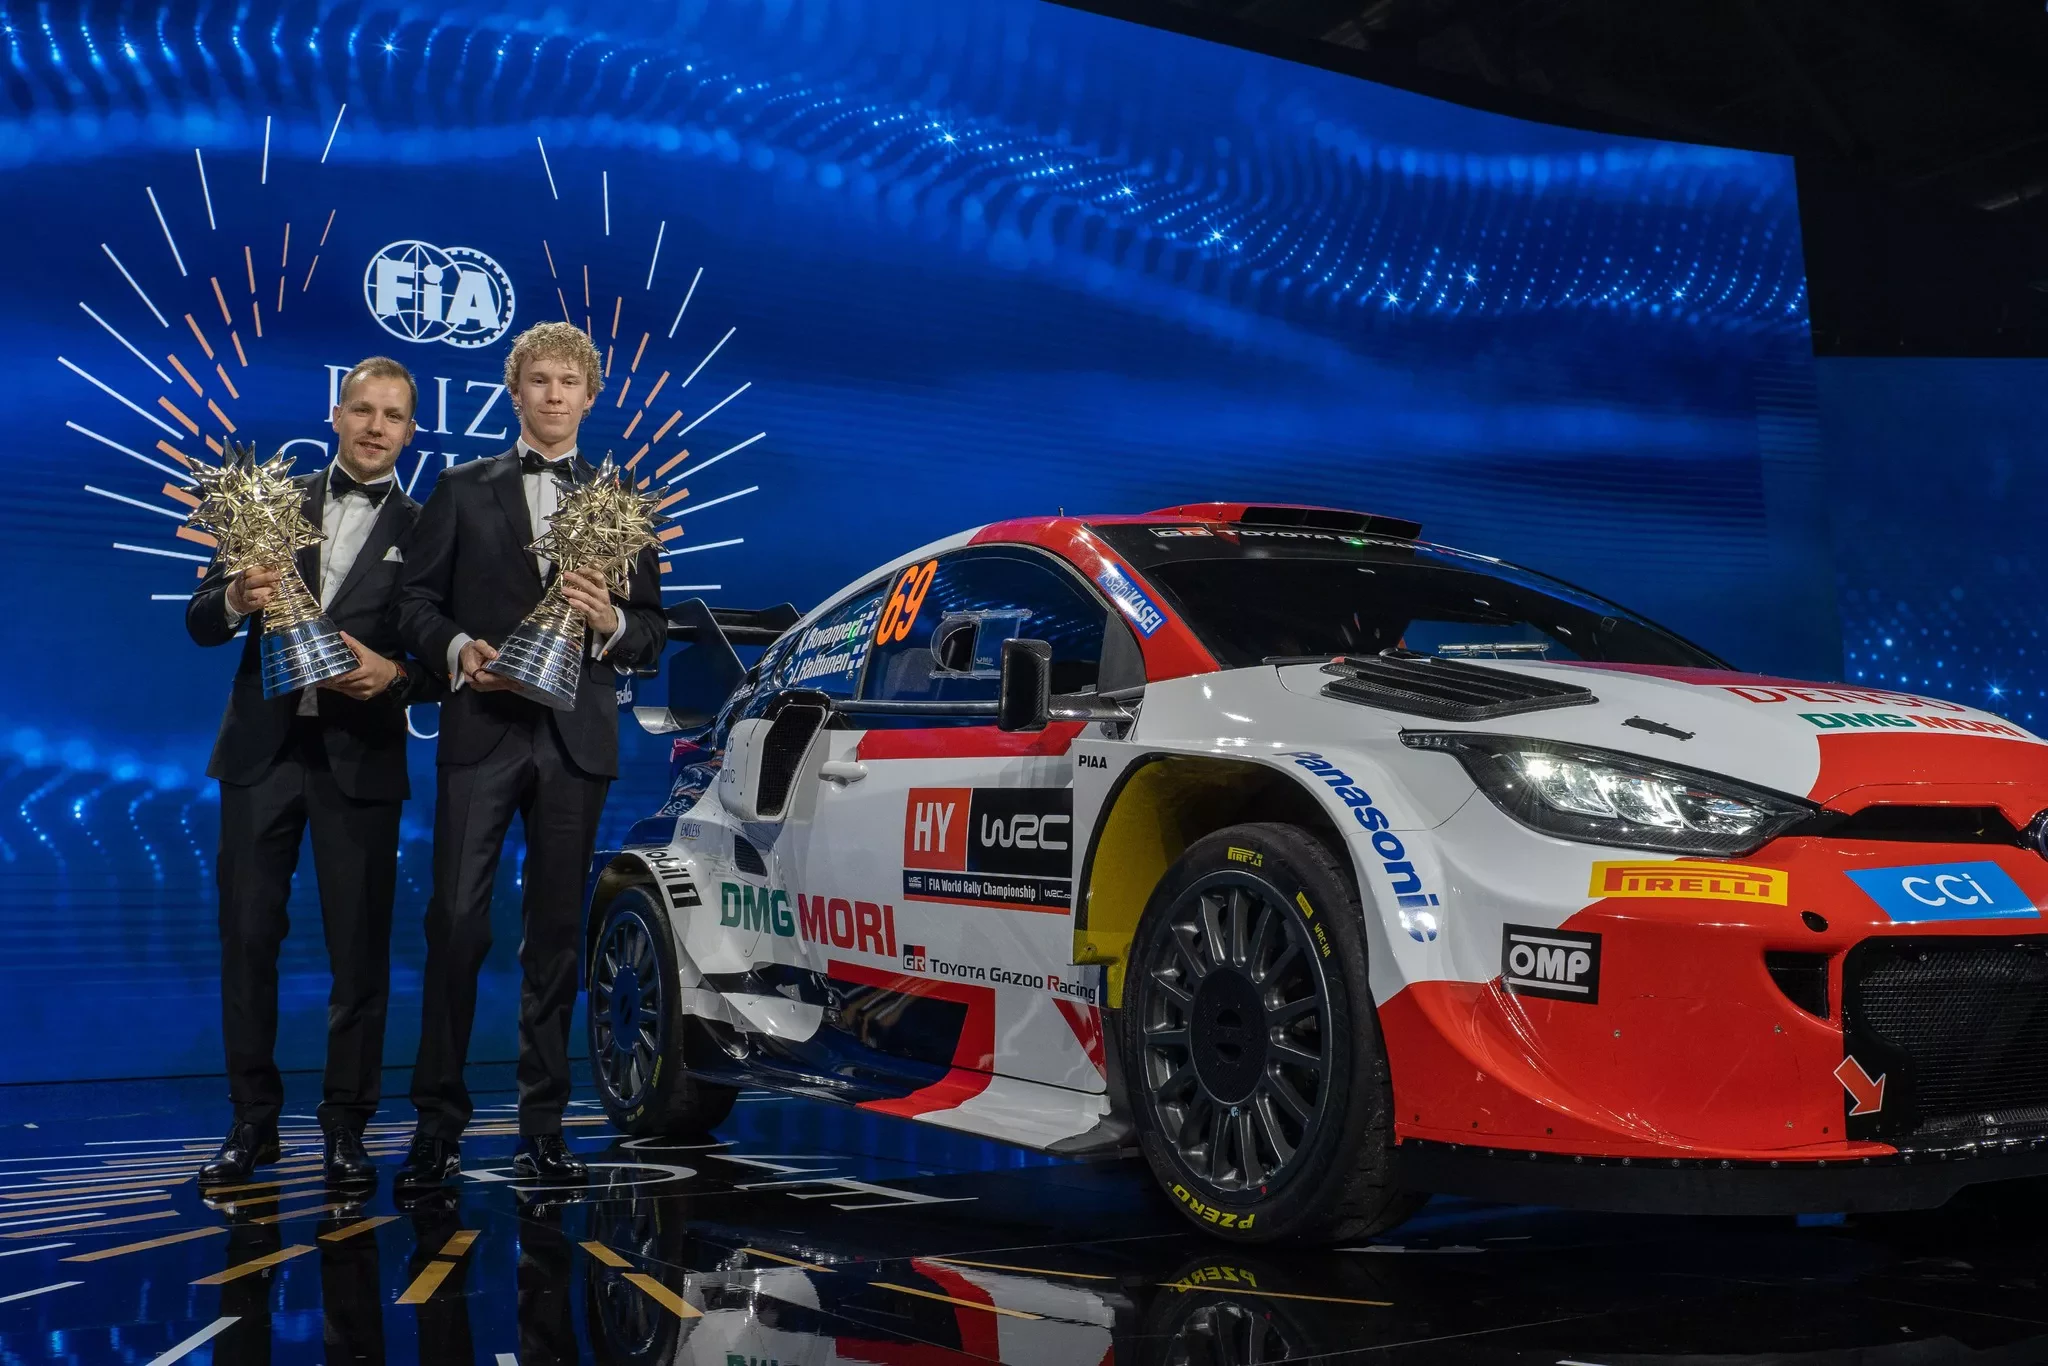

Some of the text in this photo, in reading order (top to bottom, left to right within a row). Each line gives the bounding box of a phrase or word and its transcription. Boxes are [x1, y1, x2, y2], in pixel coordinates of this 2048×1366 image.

[1216, 530, 1334, 541] TOYOTA
[877, 560, 938, 646] 69
[1720, 687, 1968, 713] DENSO
[1797, 713, 2028, 739] DMG MORI
[1077, 754, 1108, 770] PIAA
[913, 802, 1070, 853] HY WRC
[928, 878, 940, 891] FIA
[941, 879, 962, 893] World
[963, 881, 982, 897] Rally
[983, 882, 1036, 902] Championship
[1604, 867, 1773, 897] PIRELLI
[720, 882, 898, 958] DMG MORI
[1509, 945, 1591, 983] OMP
[903, 955, 1096, 1004] GR TOYOTA GAZOO Racing
